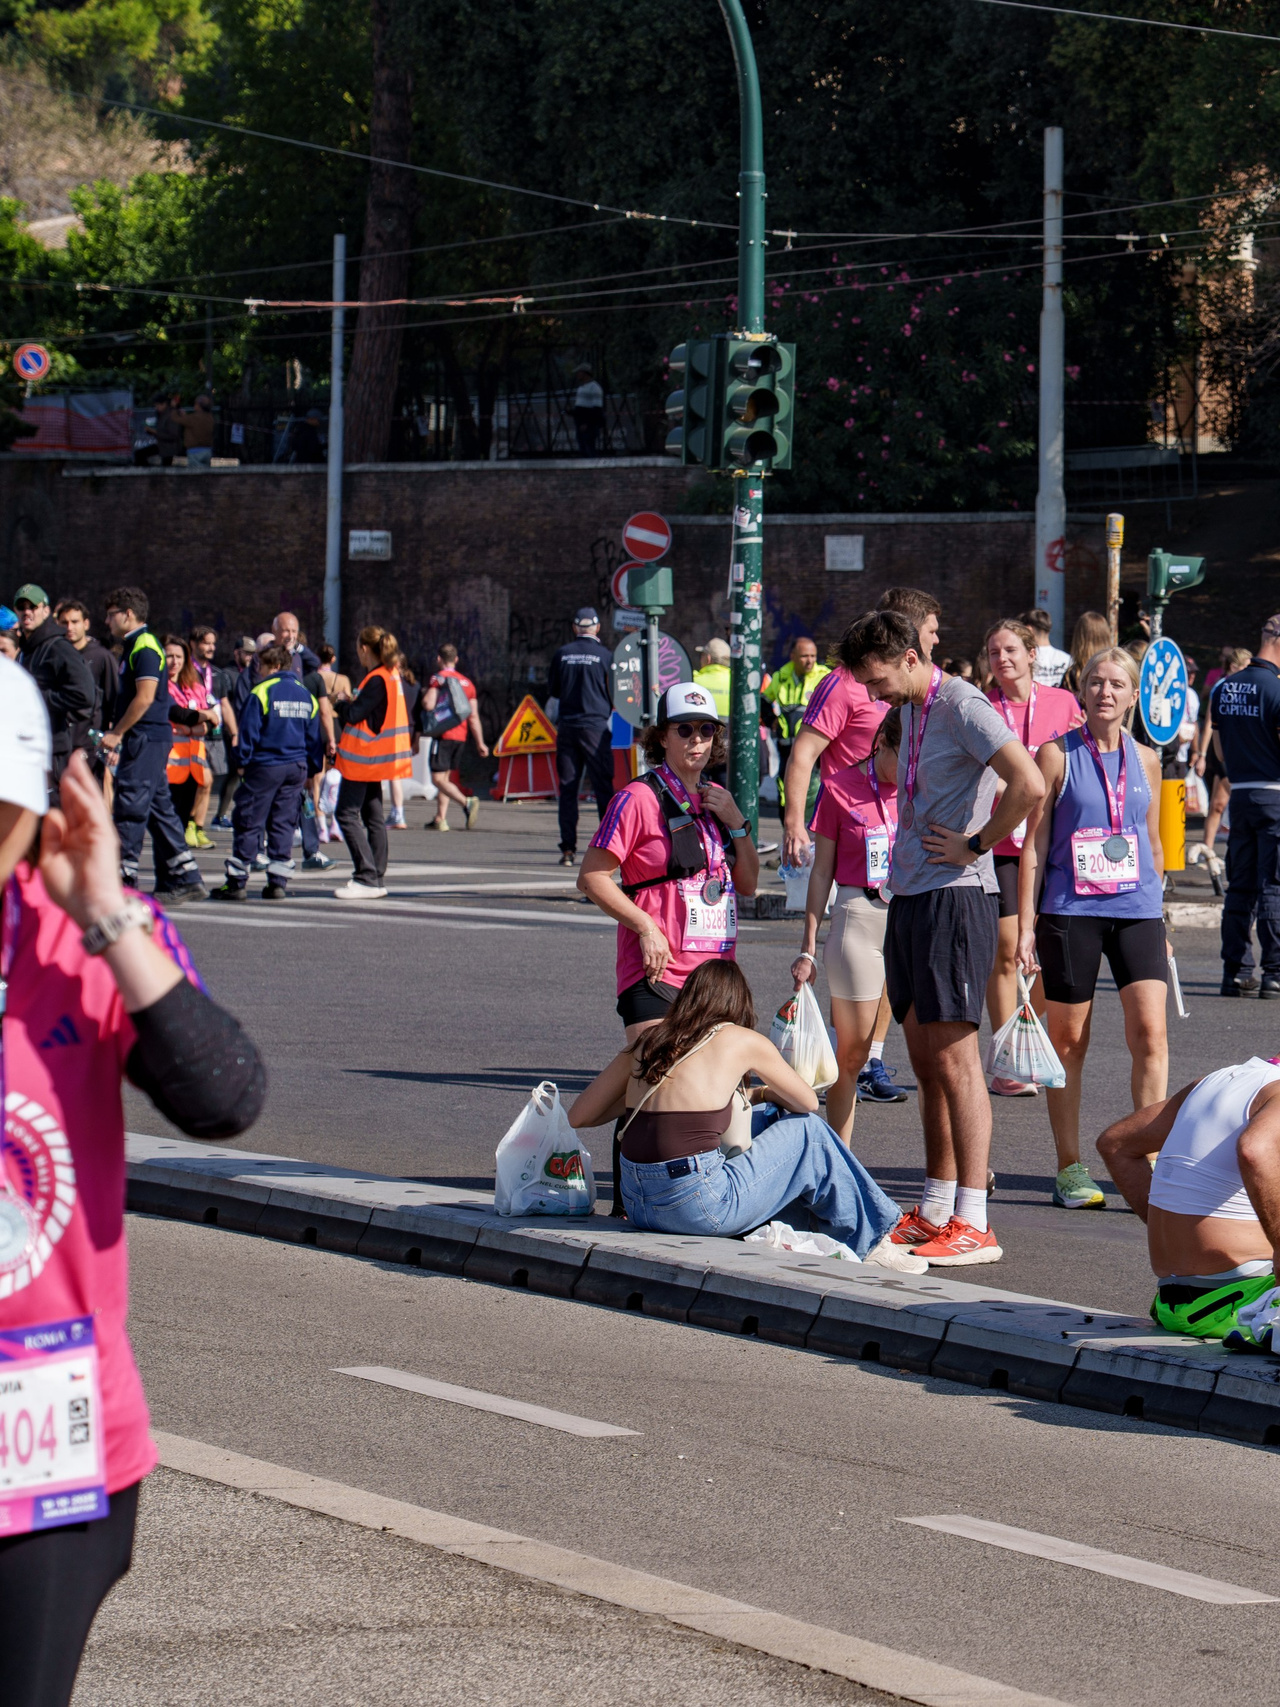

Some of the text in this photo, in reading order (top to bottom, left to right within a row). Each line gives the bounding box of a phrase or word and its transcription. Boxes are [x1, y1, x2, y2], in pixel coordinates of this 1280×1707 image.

[1221, 682, 1257, 694] POLIZIA
[1220, 693, 1247, 705] ROMA
[1219, 704, 1259, 717] CAPITALE
[701, 908, 727, 930] 13288
[24, 1329, 68, 1350] ROMA
